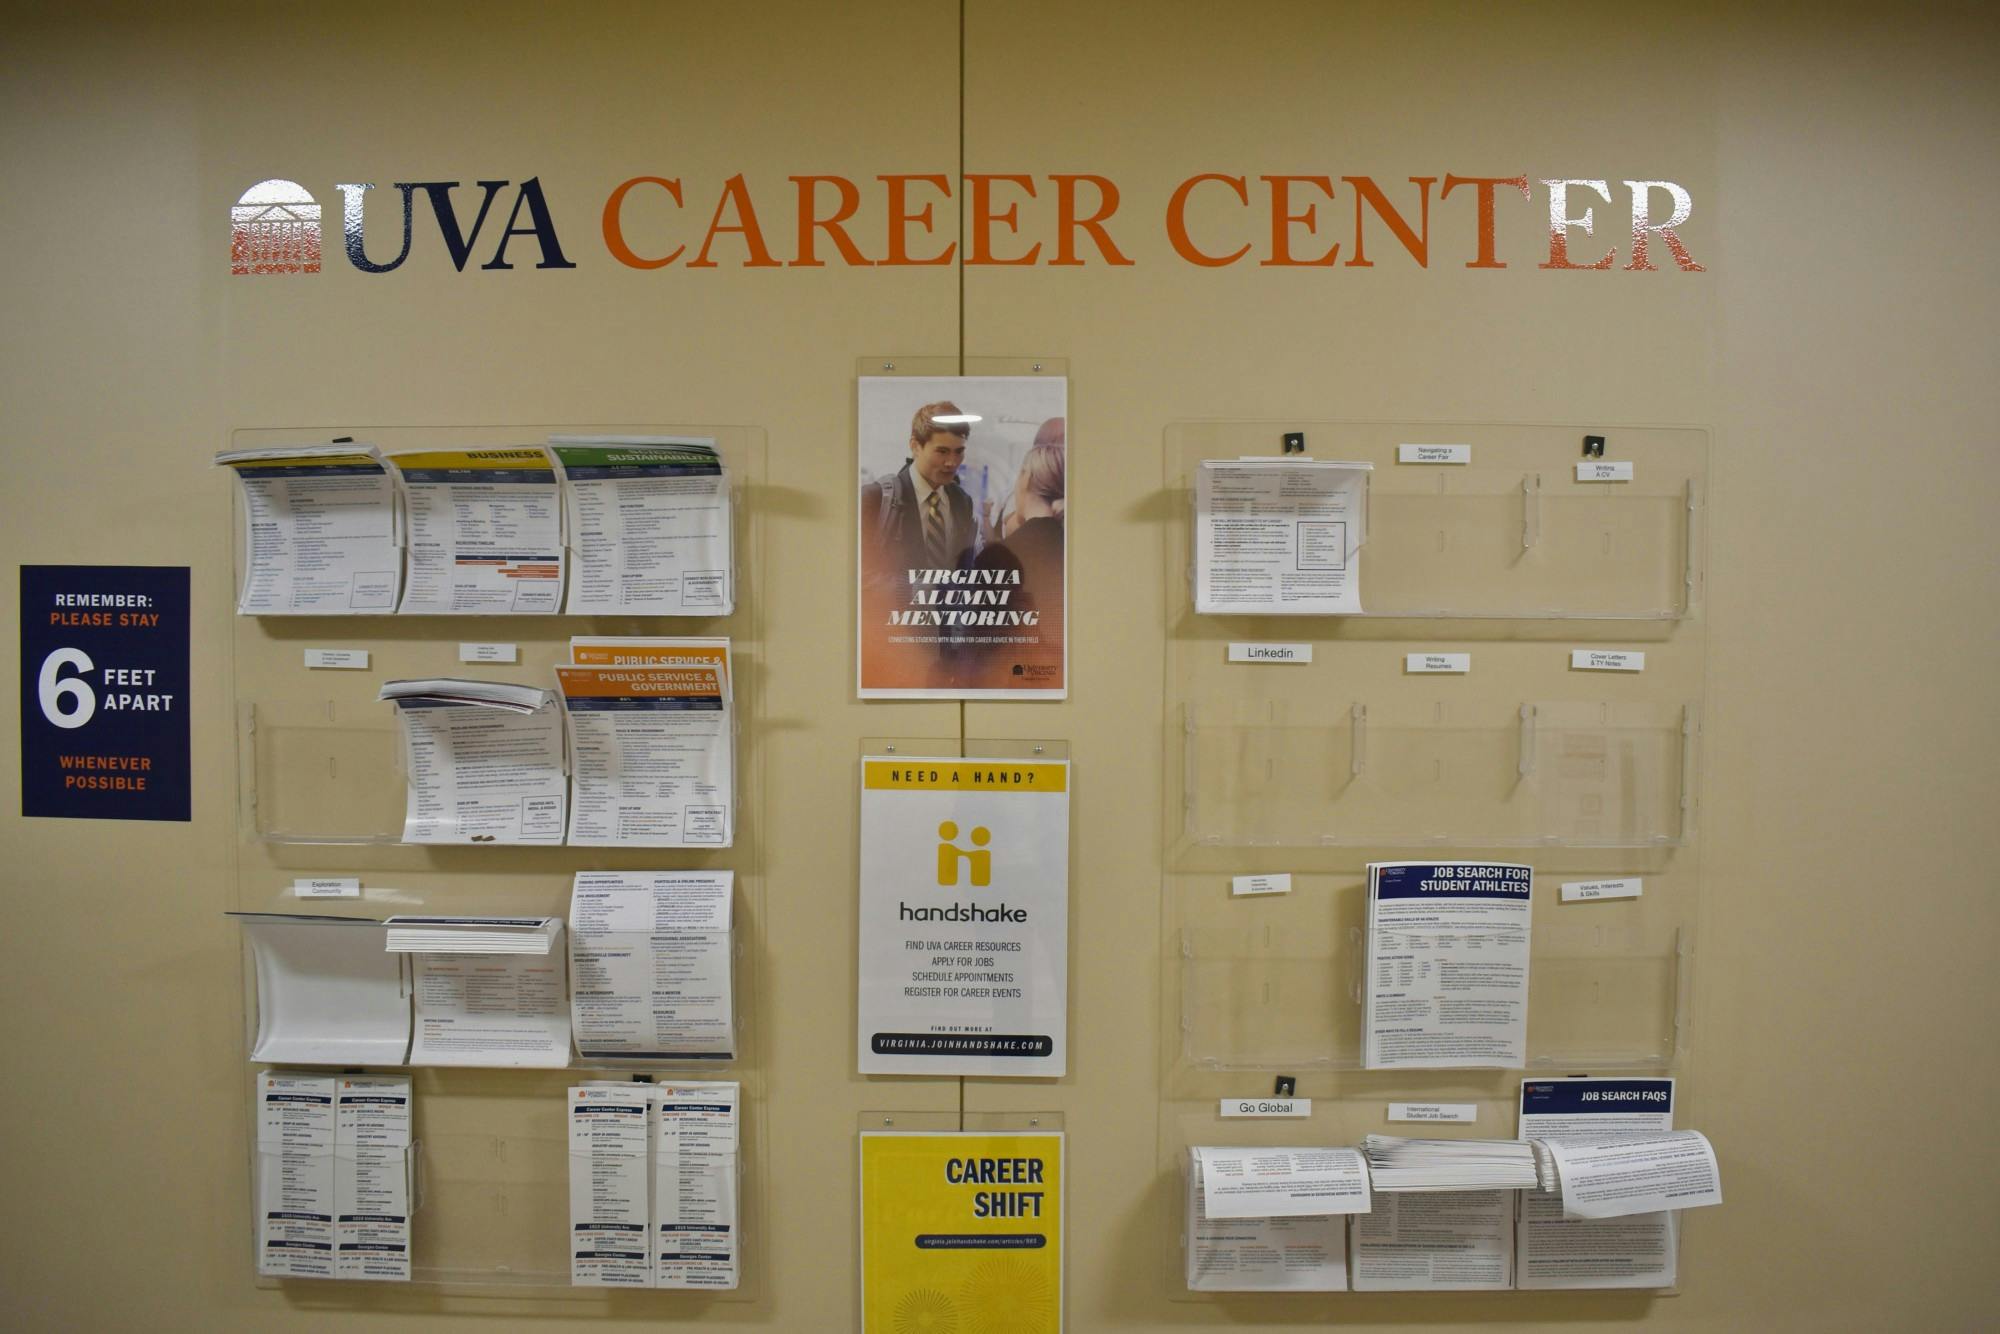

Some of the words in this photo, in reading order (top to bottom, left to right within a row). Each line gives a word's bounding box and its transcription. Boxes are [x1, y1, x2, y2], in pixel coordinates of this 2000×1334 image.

[335, 175, 576, 273] UVA
[601, 172, 1135, 271] CAREER
[1166, 172, 1706, 273] CENTER
[467, 451, 544, 459] BUSINESS
[1418, 447, 1446, 455] Navigating
[908, 569, 1021, 585] VIRGINIA
[55, 594, 153, 607] REMEMBER:
[910, 590, 1011, 605] ALUMNI
[50, 612, 113, 625] PLEASE
[119, 613, 160, 626] STAY
[885, 610, 1040, 626] MENTORING
[915, 636, 937, 644] STUDENTS
[938, 636, 949, 644] WITH
[975, 636, 992, 644] CAREER
[993, 636, 1008, 644] ADVICE
[1248, 647, 1294, 659] Linkedin
[1425, 656, 1446, 664] Writing
[598, 673, 646, 682] PUBLIC
[649, 673, 702, 682] SERVICE
[705, 673, 715, 681] &
[38, 647, 96, 729] 6
[104, 669, 156, 686] FEET
[631, 682, 718, 692] GOVERNMENT
[104, 694, 173, 711] APART
[60, 755, 151, 770] WHENEVER
[65, 776, 146, 790] POSSIBLE
[892, 770, 938, 782] NEED
[952, 771, 960, 783] A
[974, 772, 1034, 783] HAND?
[1432, 867, 1454, 878] JOB
[1456, 867, 1503, 879] SEARCH
[1506, 868, 1529, 880] FOR
[311, 881, 342, 889] Exploration
[1420, 880, 1471, 891] STUDENT
[1472, 881, 1529, 893] ATHLETES
[900, 901, 1028, 923] handshake
[905, 940, 924, 950] FIND
[926, 941, 942, 950] UVA
[943, 941, 973, 951] CAREER
[975, 942, 1021, 951] RESOURCES
[931, 957, 954, 966] APPLY
[957, 957, 972, 966] FOR
[974, 958, 994, 967] JOBS
[912, 972, 953, 981] SCHEDULE
[954, 972, 1014, 982] APPOINTMENTS
[904, 987, 941, 997] REGISTER
[943, 988, 959, 997] FOR
[960, 988, 990, 998] CAREER
[992, 988, 1021, 998] EVENTS
[879, 1039, 1044, 1050] VIRGINIA.JOINHANDSHAKE.COM
[1581, 1091, 1600, 1101] JOB
[1601, 1091, 1640, 1101] SEARCH
[1641, 1091, 1667, 1101] FAQS
[1239, 1103, 1256, 1113] Go
[1258, 1102, 1293, 1113] Global
[946, 1158, 1044, 1184] CAREER
[974, 1191, 1044, 1217] SHIFT
